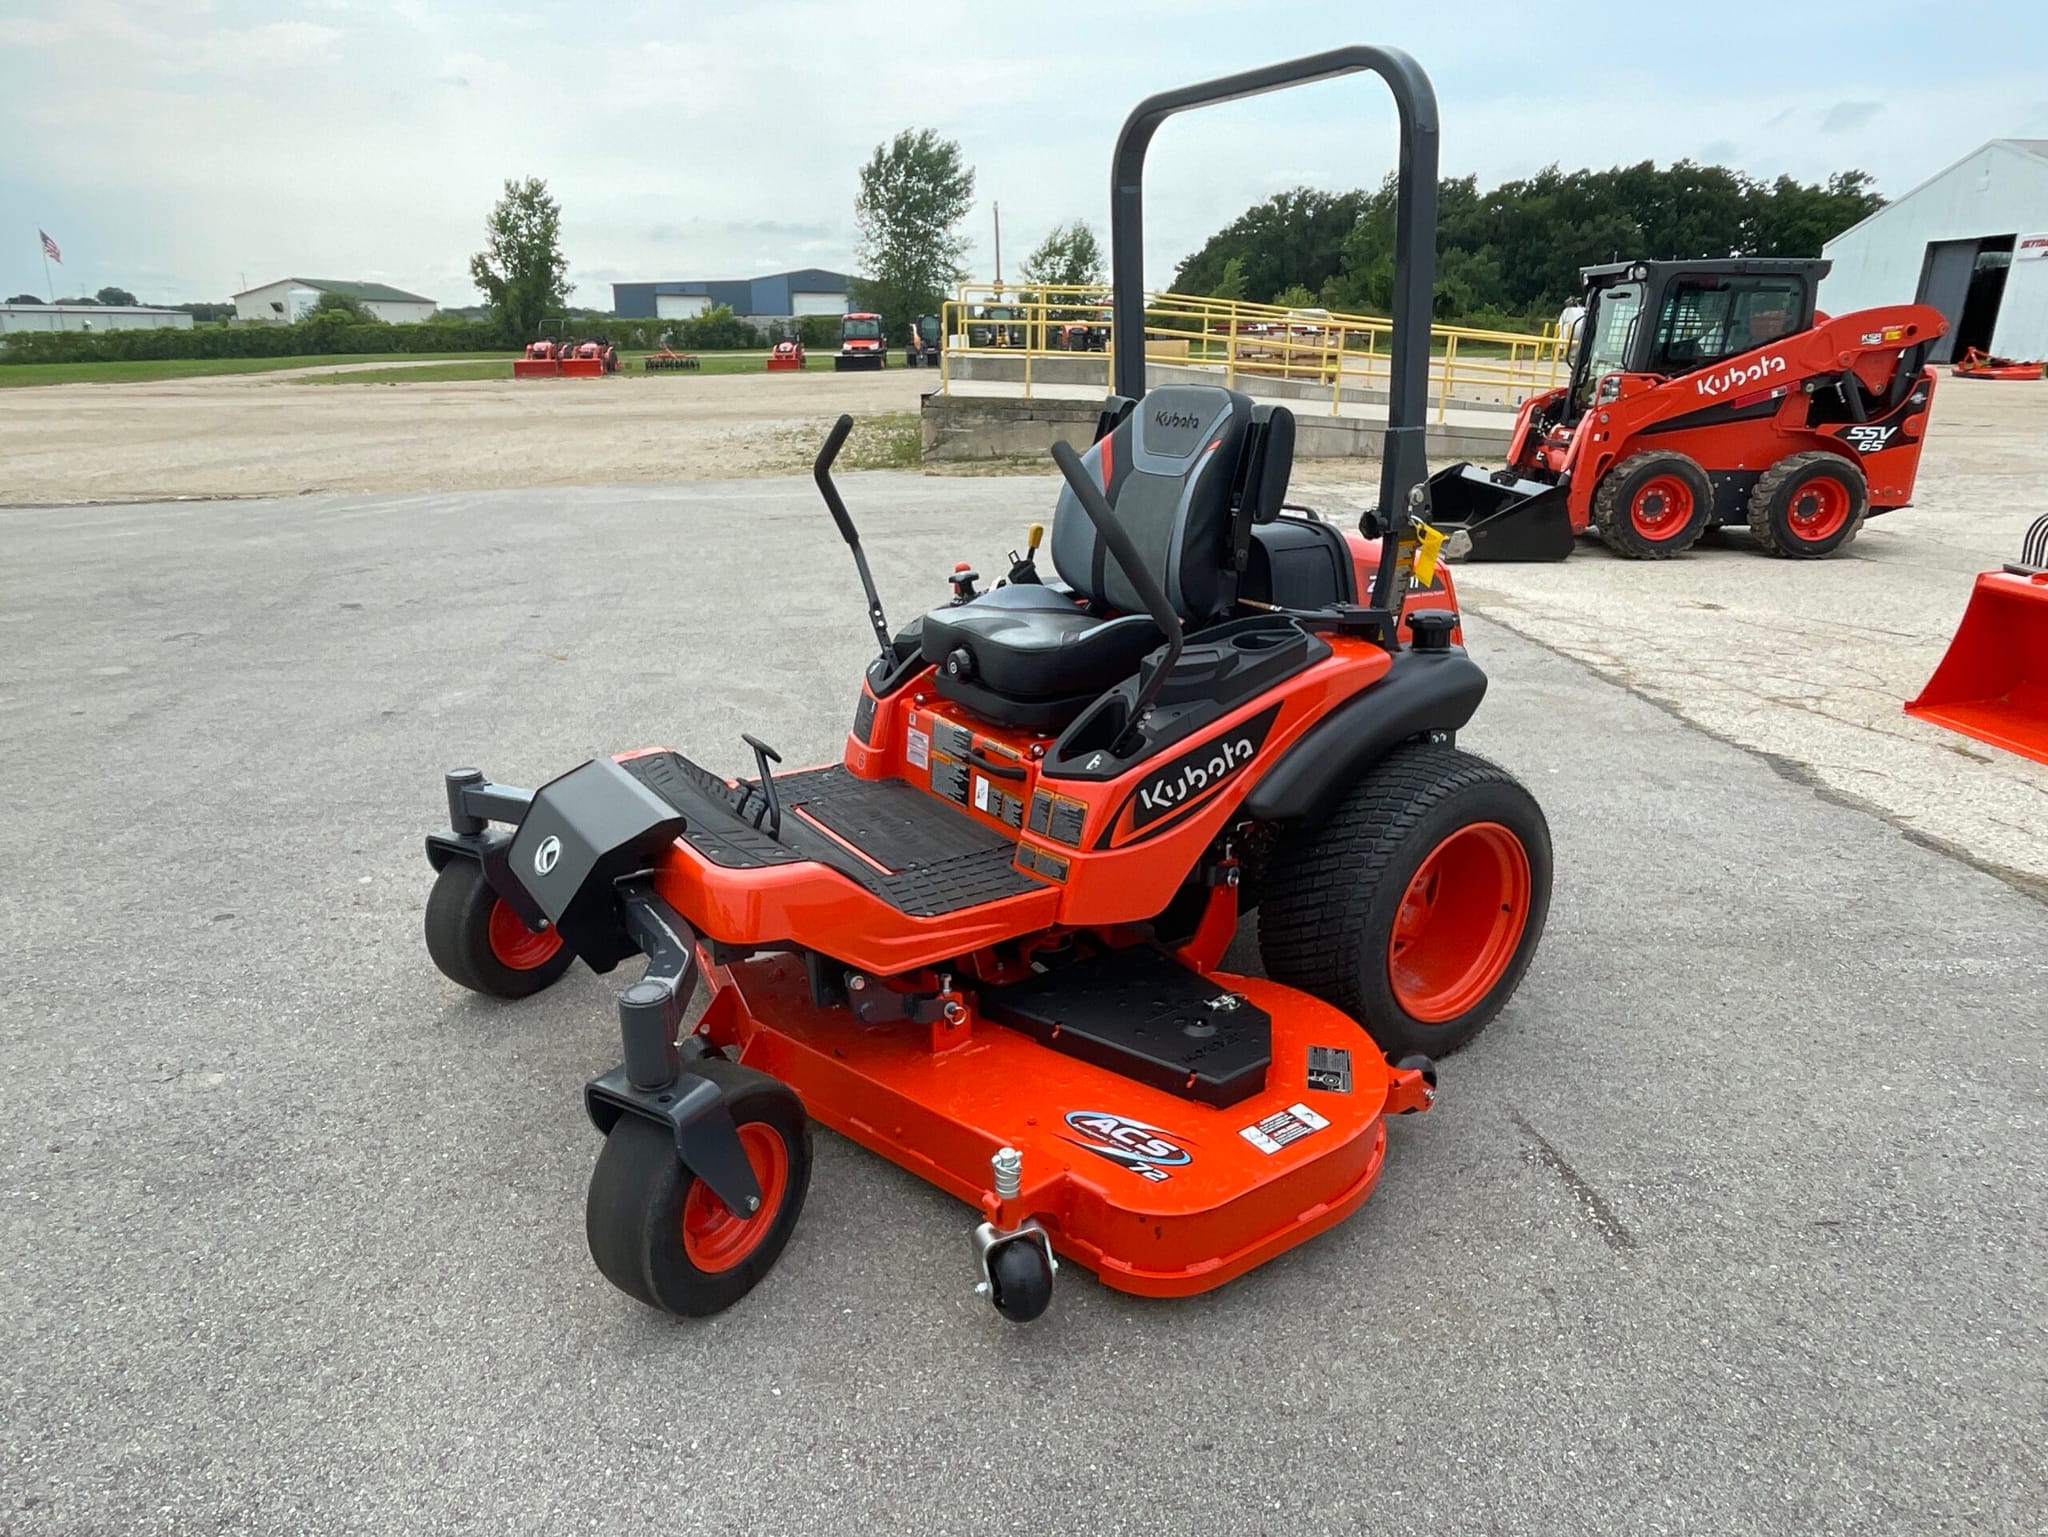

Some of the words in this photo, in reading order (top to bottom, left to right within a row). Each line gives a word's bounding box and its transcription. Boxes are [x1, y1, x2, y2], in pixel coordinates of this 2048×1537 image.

[1697, 355, 1786, 396] Kubota
[1155, 410, 1200, 429] Kubota
[1846, 426, 1898, 440] SSV
[1858, 440, 1886, 452] 65
[1139, 738, 1254, 810] Kubota
[1080, 1117, 1180, 1158] ACS
[1128, 1161, 1170, 1182] 72
